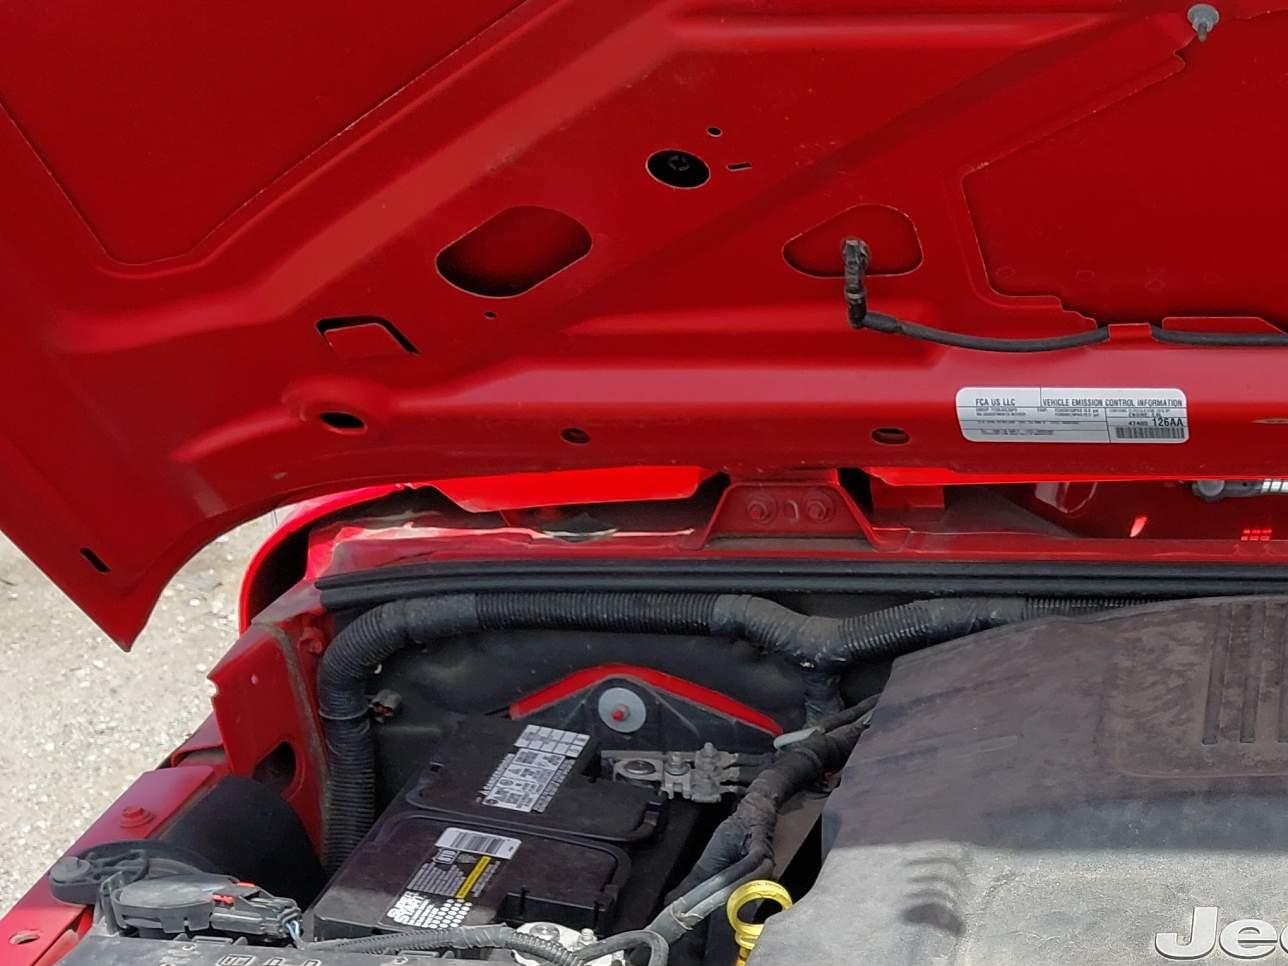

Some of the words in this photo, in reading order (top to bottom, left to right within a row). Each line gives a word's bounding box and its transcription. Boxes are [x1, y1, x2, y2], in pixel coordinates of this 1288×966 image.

[976, 398, 989, 407] FCA
[991, 398, 1001, 407] US
[1003, 398, 1016, 407] LLC
[1042, 398, 1070, 407] VEHICLE
[1071, 398, 1103, 407] EMISSION
[1105, 398, 1135, 407] CONTROL
[1137, 399, 1183, 407] INFORMATION
[1152, 417, 1184, 427] 126AA
